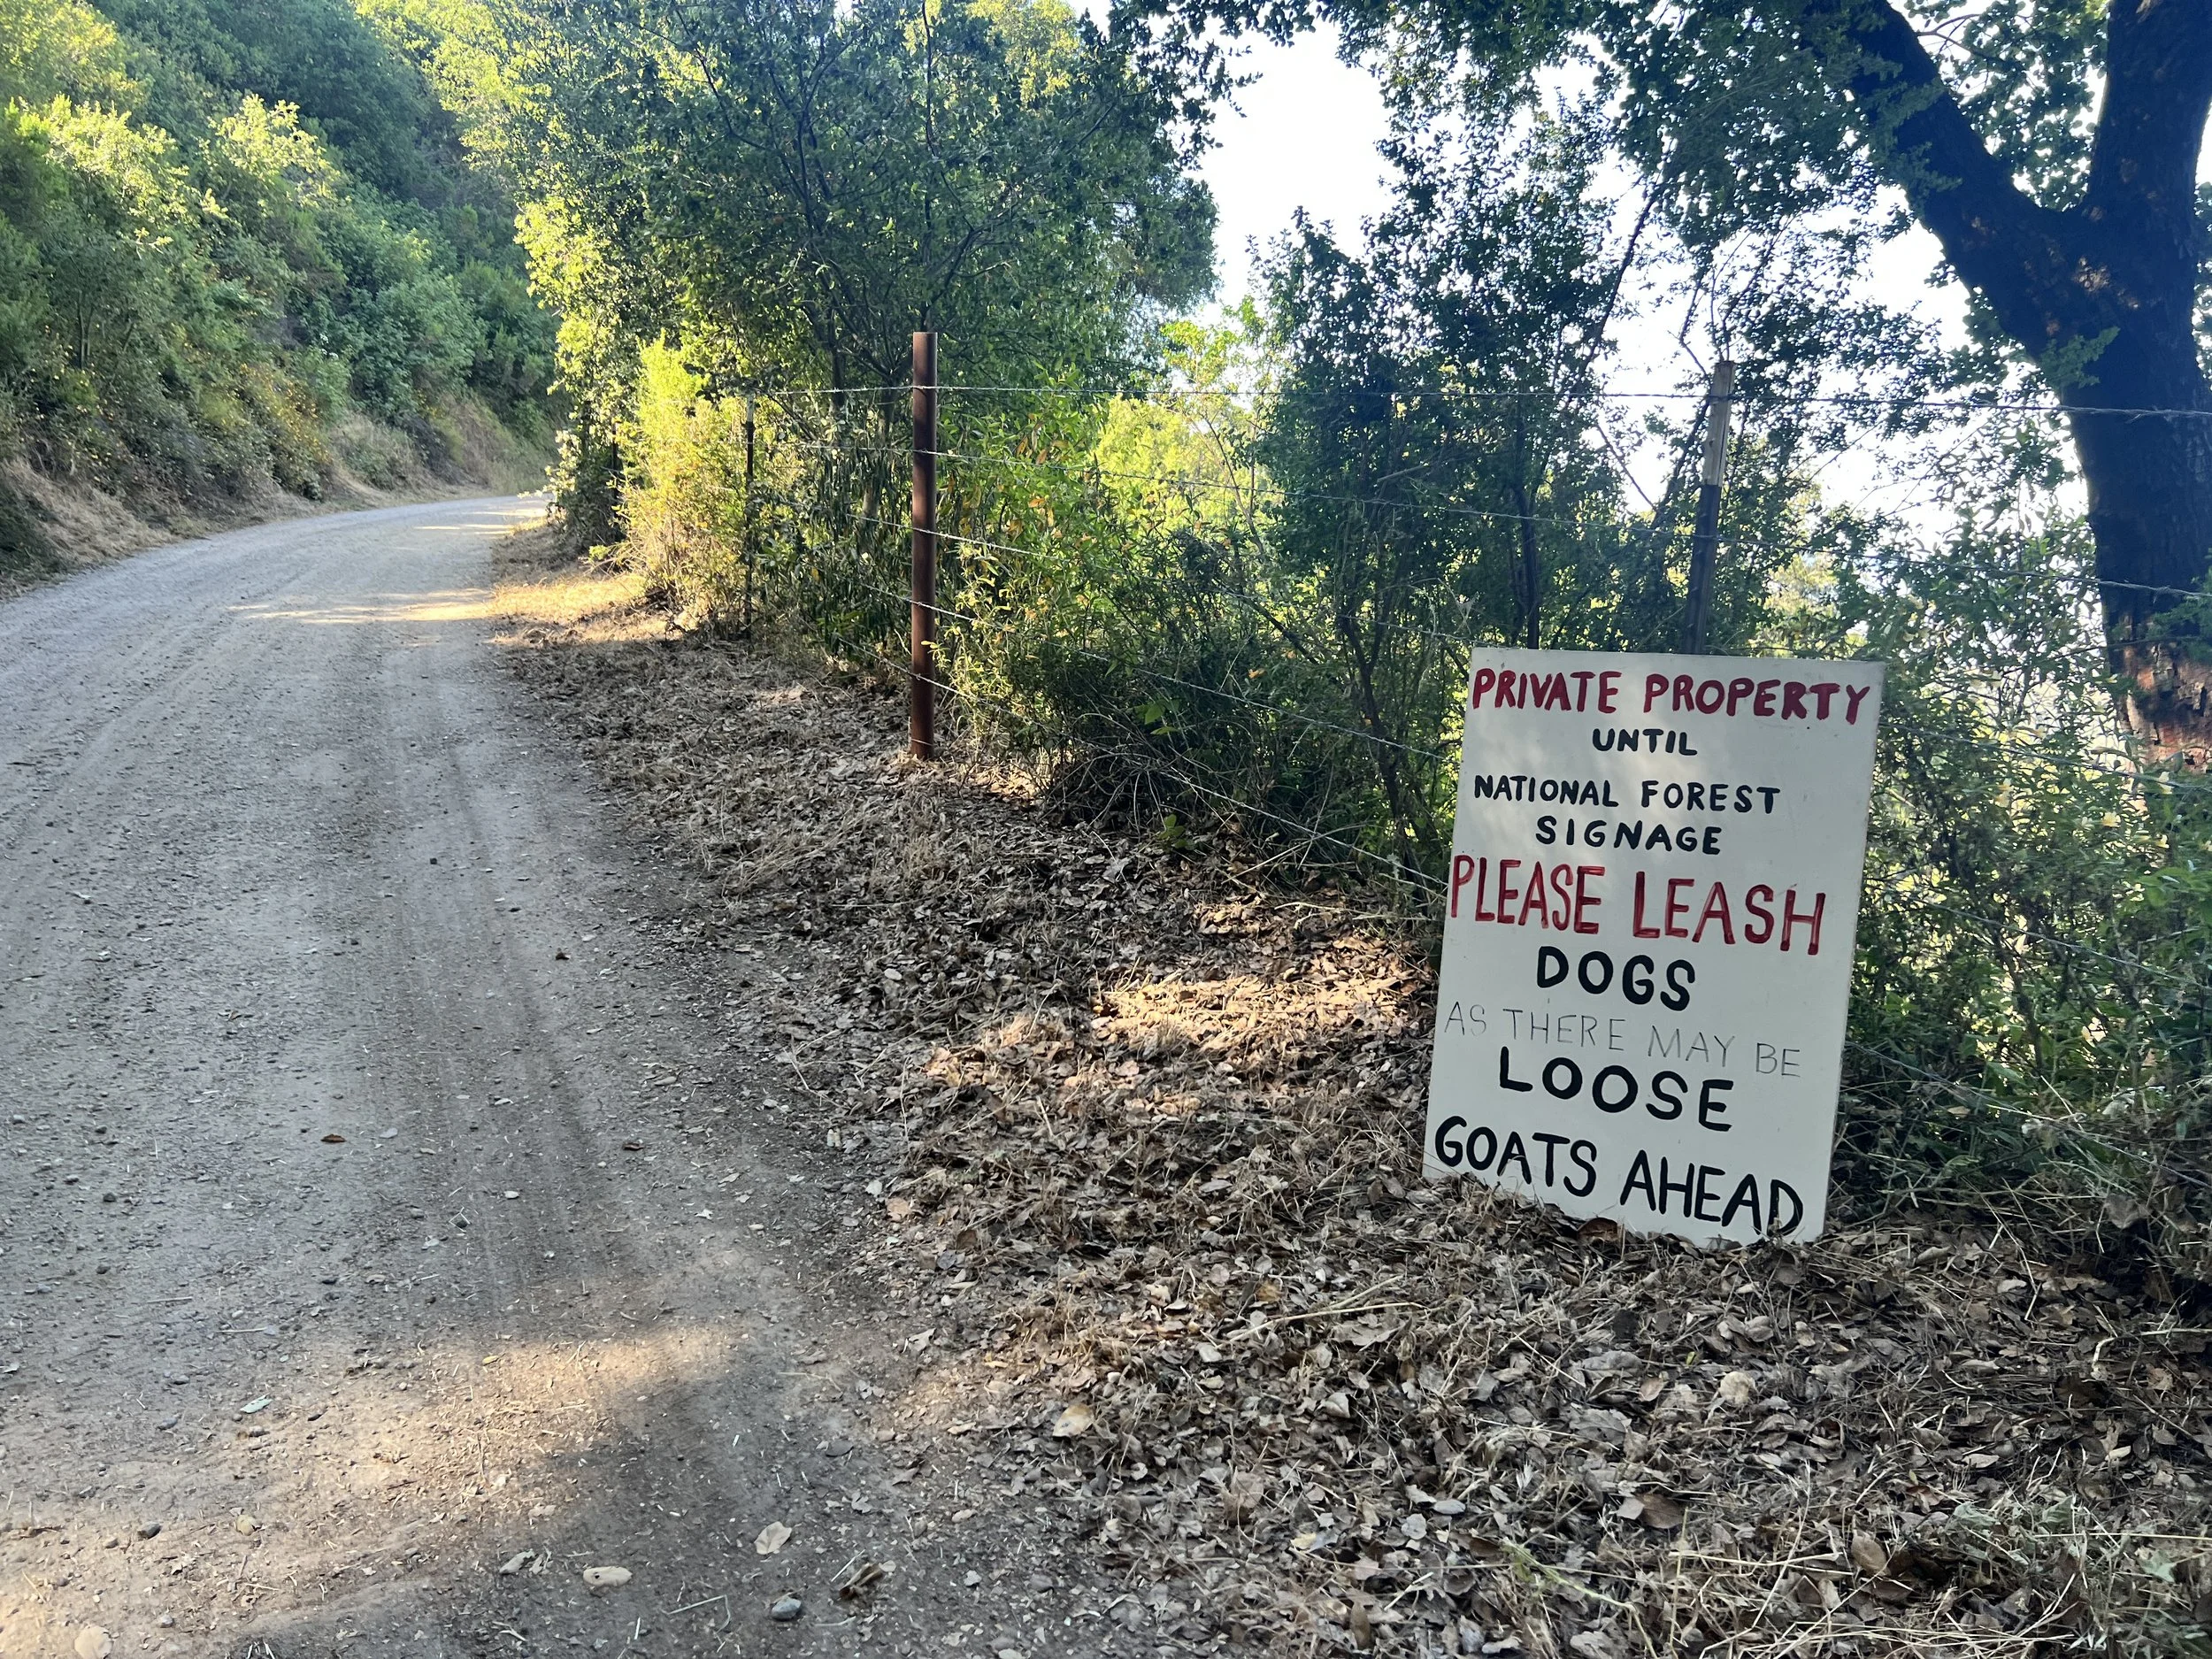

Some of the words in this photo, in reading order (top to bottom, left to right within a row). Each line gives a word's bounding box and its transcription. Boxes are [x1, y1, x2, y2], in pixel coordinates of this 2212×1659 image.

[1472, 668, 1622, 714] PRIVATE
[1643, 673, 1870, 725] PROPERTY
[1593, 728, 1697, 756] UNTIL
[1474, 775, 1619, 808] NATIONAL
[1641, 780, 1780, 814] FOREST
[1535, 816, 1722, 855] SIGNAGE
[1450, 855, 1605, 935] PLEASE
[1633, 871, 1826, 956] LEASH
[1537, 946, 1695, 1011] DOGS
[1444, 1002, 1486, 1036] AS
[1503, 1009, 1626, 1051] THERE
[1647, 1025, 1735, 1067] MAY
[1756, 1043, 1801, 1078] BE
[1500, 1047, 1734, 1132] LOOSE
[1435, 1116, 1596, 1197] GOATS
[1620, 1150, 1803, 1237] AHEAD
